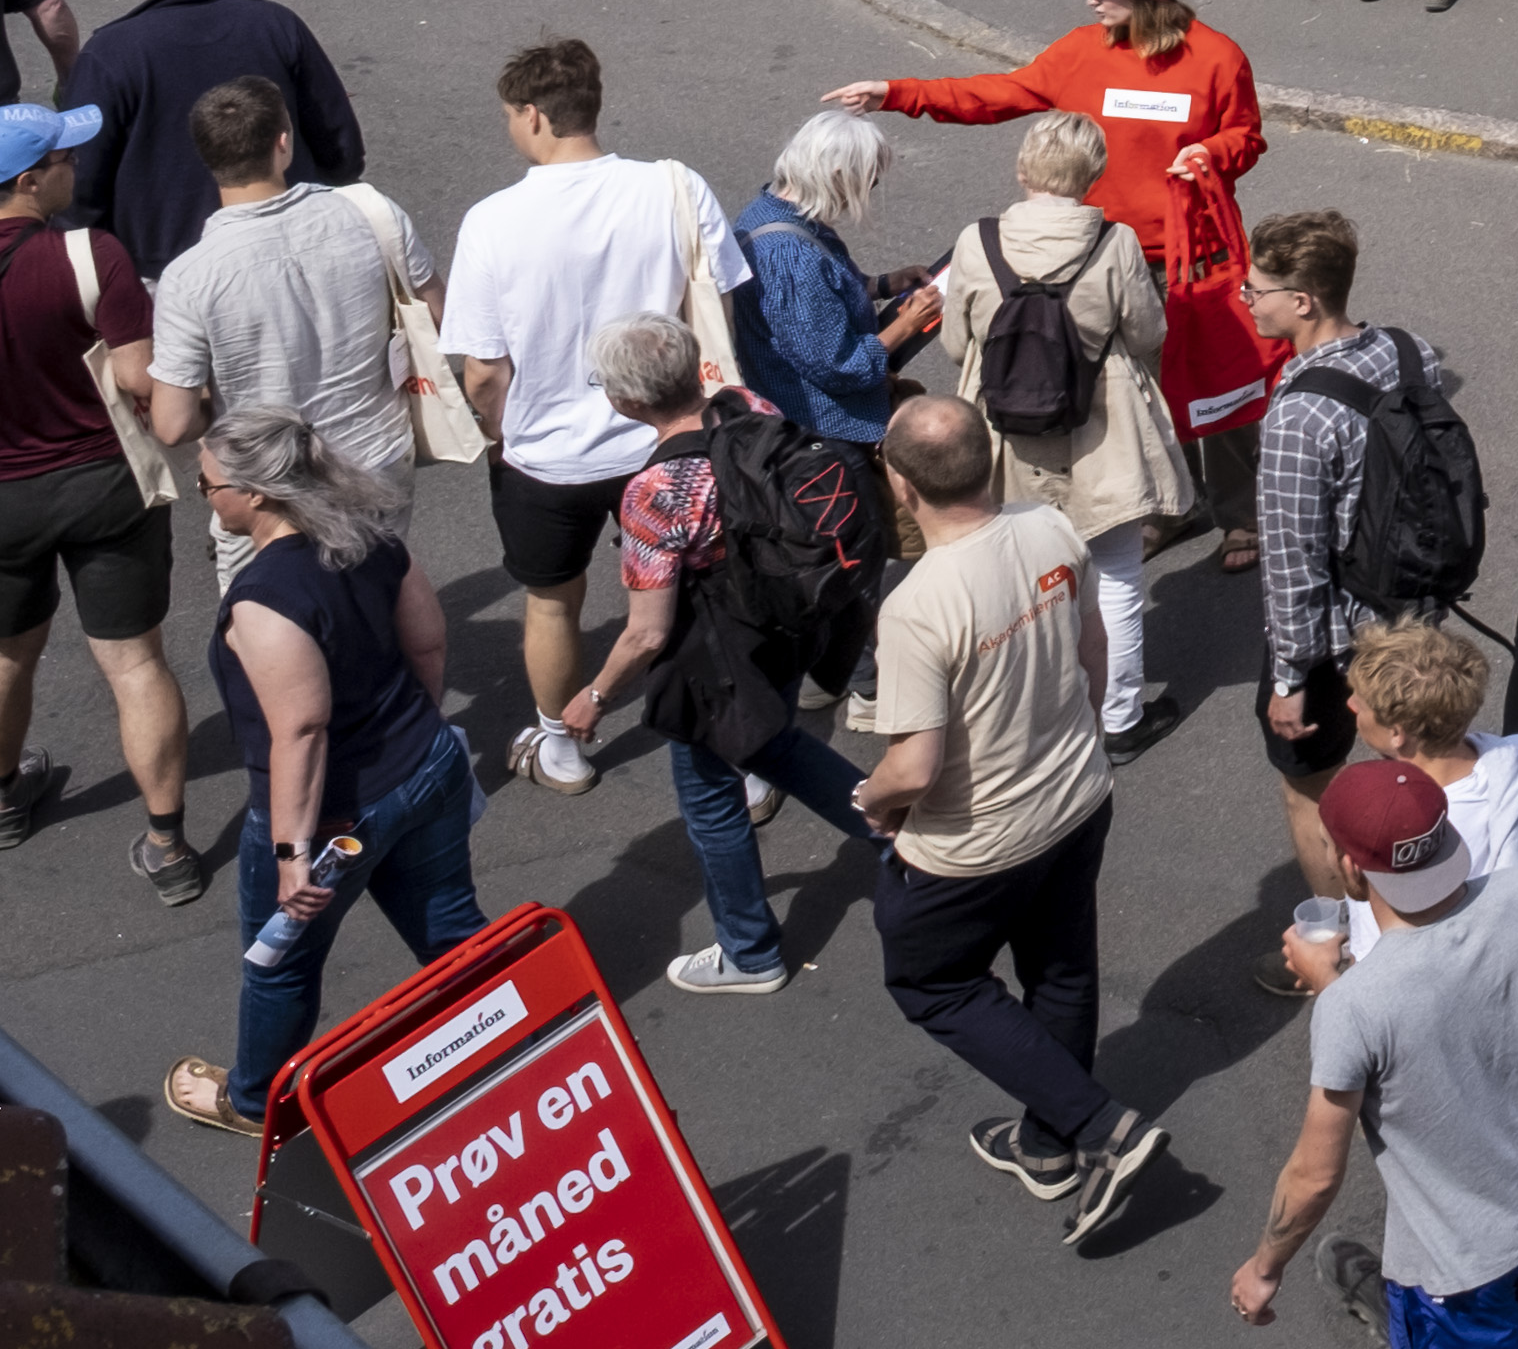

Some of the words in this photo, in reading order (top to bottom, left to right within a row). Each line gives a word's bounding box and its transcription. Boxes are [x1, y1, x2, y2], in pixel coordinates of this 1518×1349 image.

[1113, 98, 1178, 114] Information
[1196, 389, 1257, 417] Information
[1045, 571, 1061, 587] AC
[406, 1005, 507, 1082] Information
[389, 1109, 527, 1232] Prøv
[536, 1060, 614, 1132] en
[433, 1127, 635, 1306] måned
[471, 1235, 635, 1349] gratis
